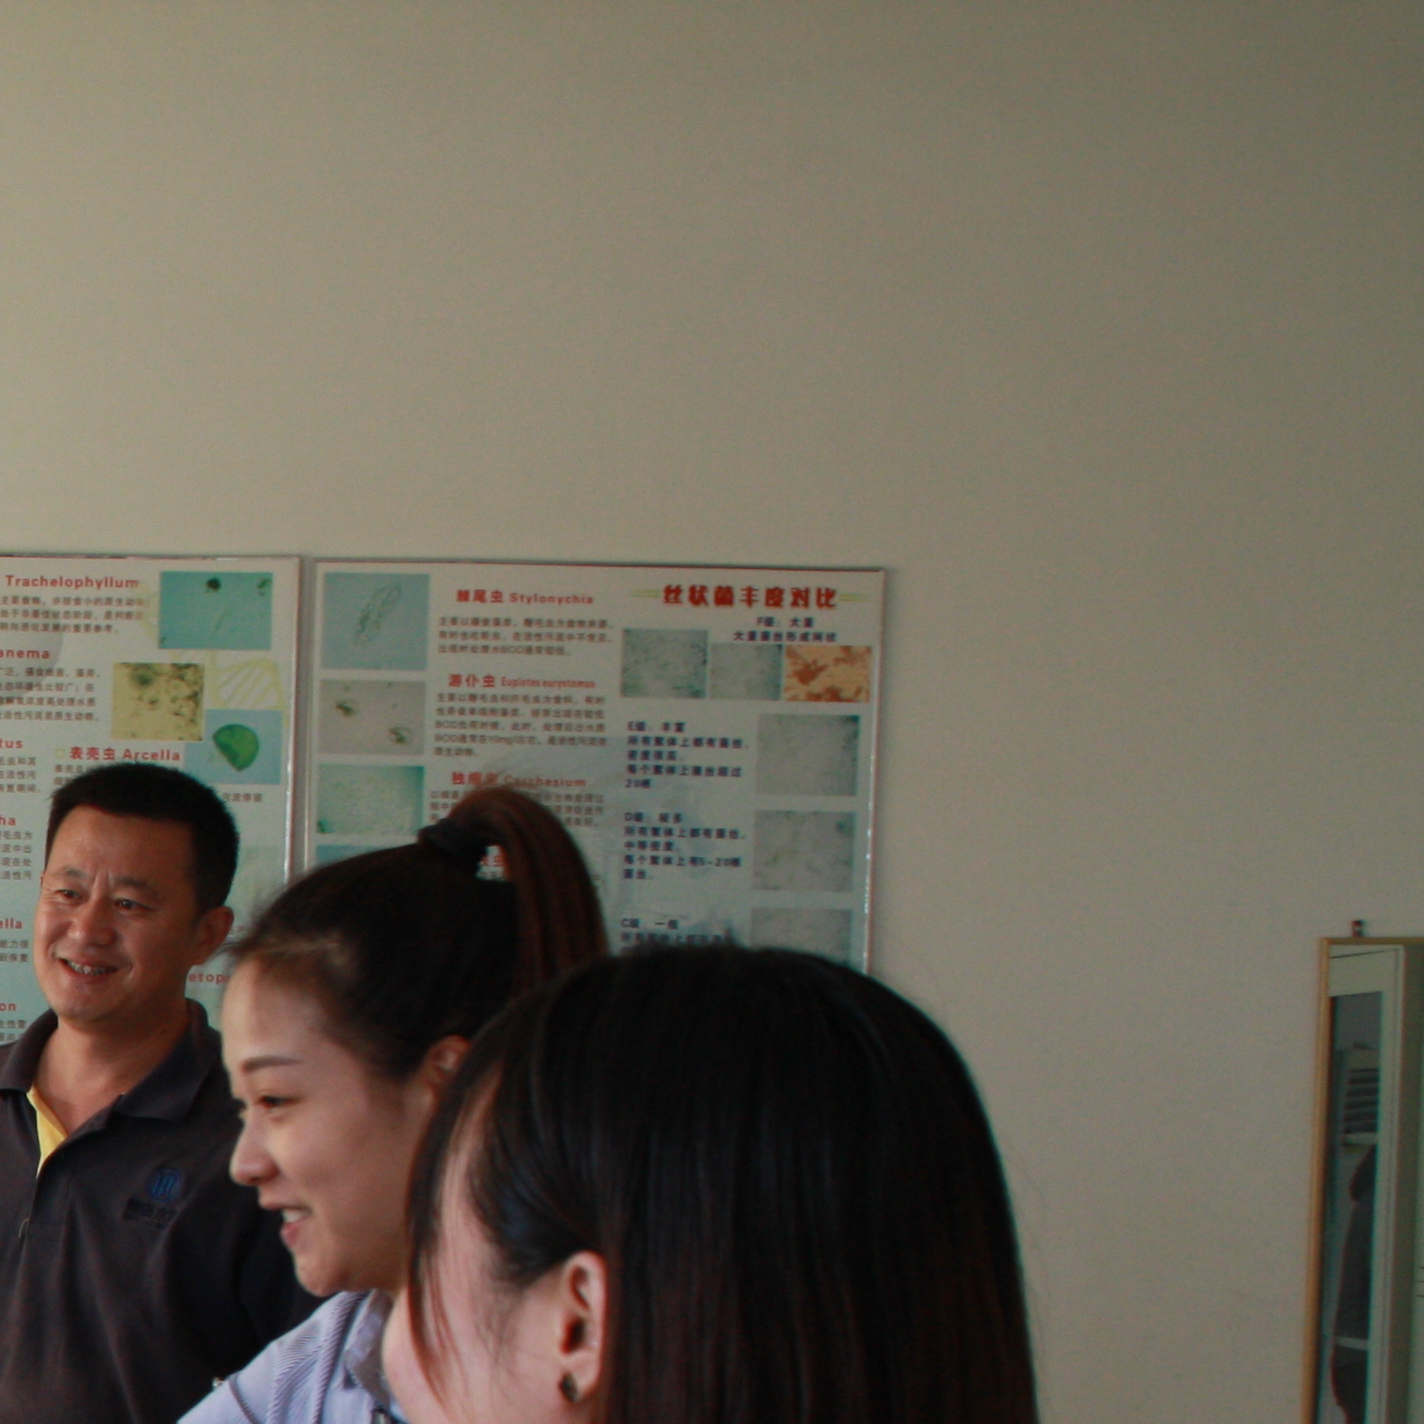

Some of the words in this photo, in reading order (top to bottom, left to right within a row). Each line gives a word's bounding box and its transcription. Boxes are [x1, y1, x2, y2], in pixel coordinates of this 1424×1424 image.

[5, 574, 139, 590] Trachelophyllum
[509, 592, 594, 606] Stylonychia
[663, 585, 838, 609] 丝状菌丰度对比
[69, 747, 117, 760] 表壳虫
[122, 748, 181, 761] Arcella
